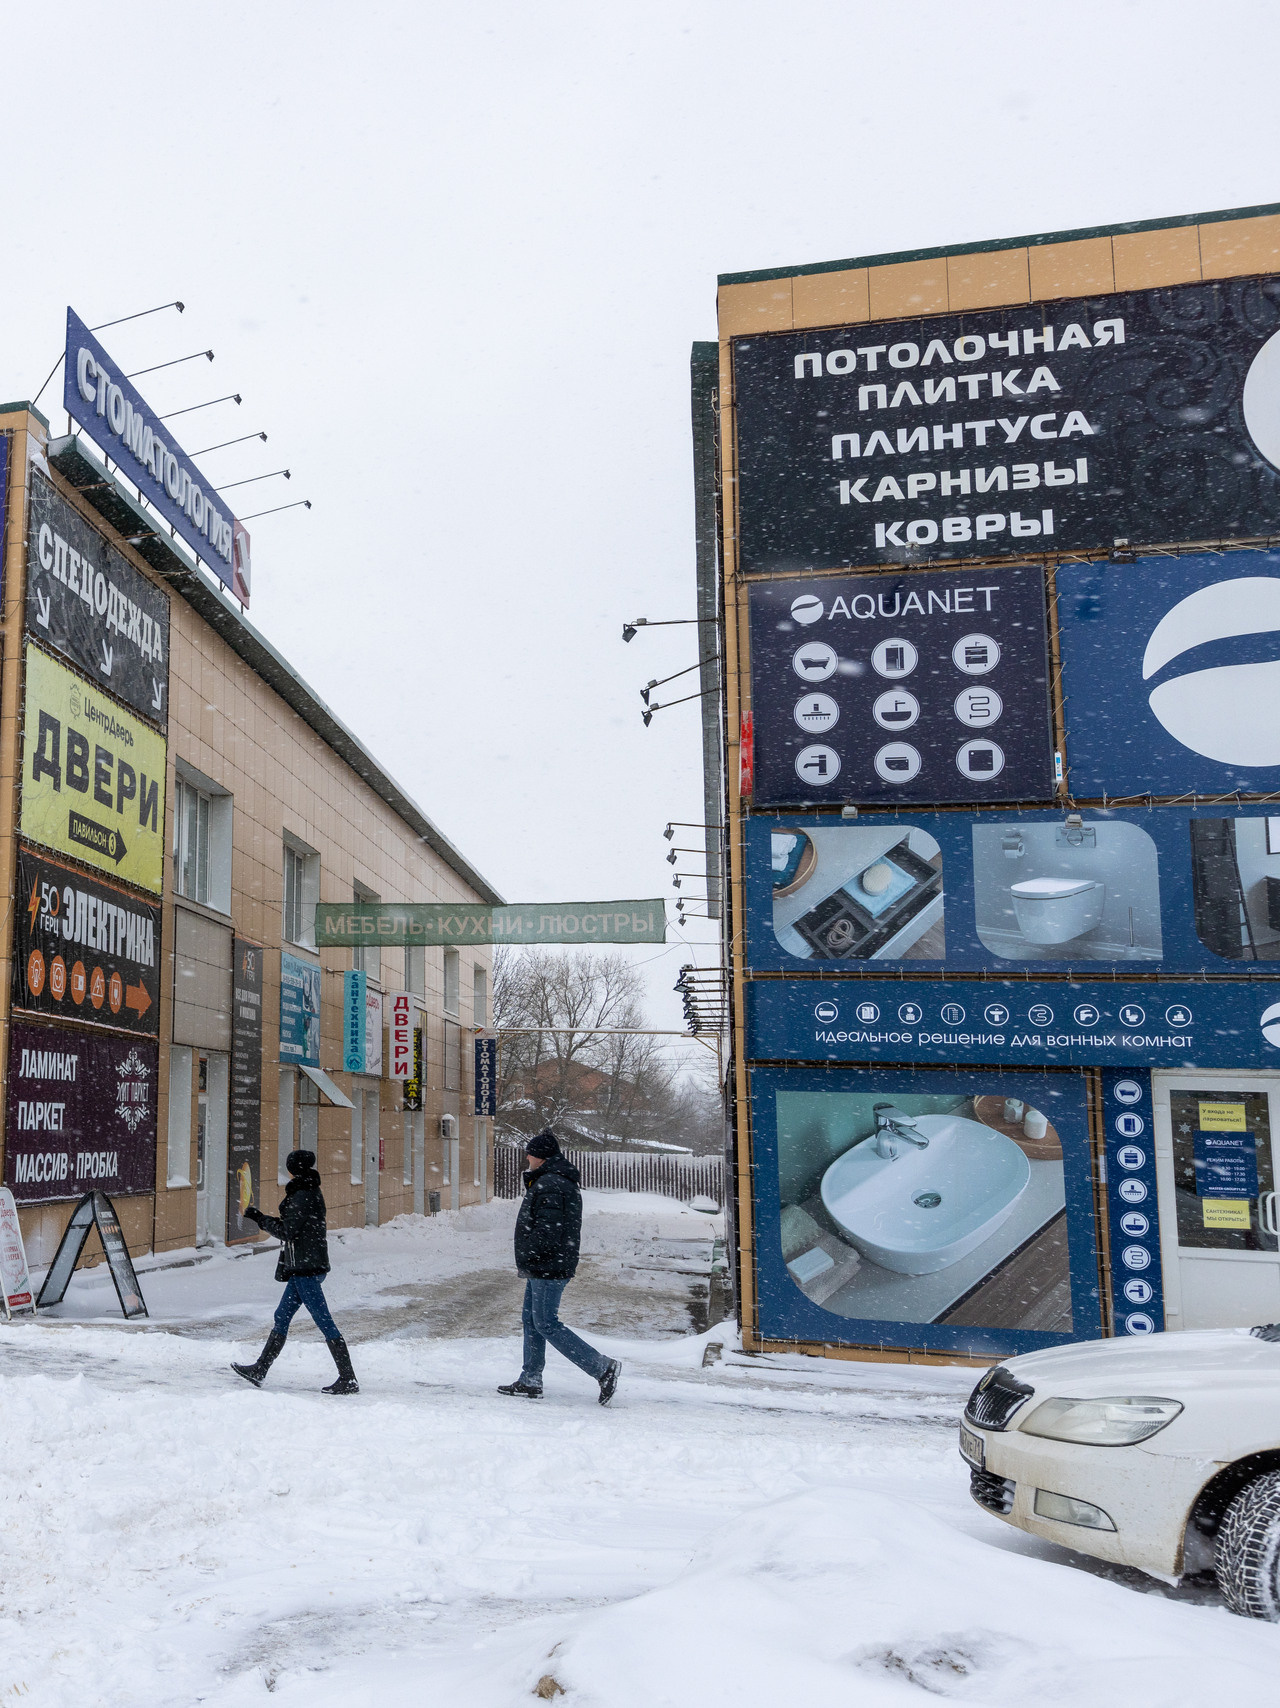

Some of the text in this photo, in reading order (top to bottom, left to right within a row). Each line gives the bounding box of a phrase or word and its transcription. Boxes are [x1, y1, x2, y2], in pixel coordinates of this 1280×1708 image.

[794, 318, 1126, 379] ПОТОЛОЧНАЯ
[857, 366, 1060, 411] ПЛИТКА
[76, 347, 233, 564] СТОМАТОЛОГИЯ
[831, 410, 1095, 460] ПЛИНТУСА
[839, 457, 1089, 506] КАРНИЗЫ
[874, 509, 1055, 549] КОВРЫ
[38, 522, 163, 663] СПЕЦОДЕЖДА
[828, 586, 1000, 621] AQUANET
[84, 696, 134, 748] ЦентрДверь
[32, 708, 159, 834] ДВЕРИ
[72, 818, 108, 849] ПАВИЛЬОН
[40, 882, 60, 917] 50
[40, 914, 59, 938] ГЕРЦ
[62, 886, 155, 967] ЭЛЕКТРИКА
[325, 912, 655, 936] МЕБЕЛЬ КУХНИ ЛЮСТРЫ
[350, 973, 359, 1053] сантехника
[393, 996, 410, 1075] ДВЕРИ
[815, 1030, 1193, 1048] идеальное решение для ванных комнат
[19, 1049, 78, 1081] ЛАМИНАТ
[480, 1039, 490, 1115] СТОМАТОЛОГИЯ
[17, 1101, 66, 1131] ПАРКЕТ
[15, 1151, 118, 1183] МАССИВ ПРОБКА
